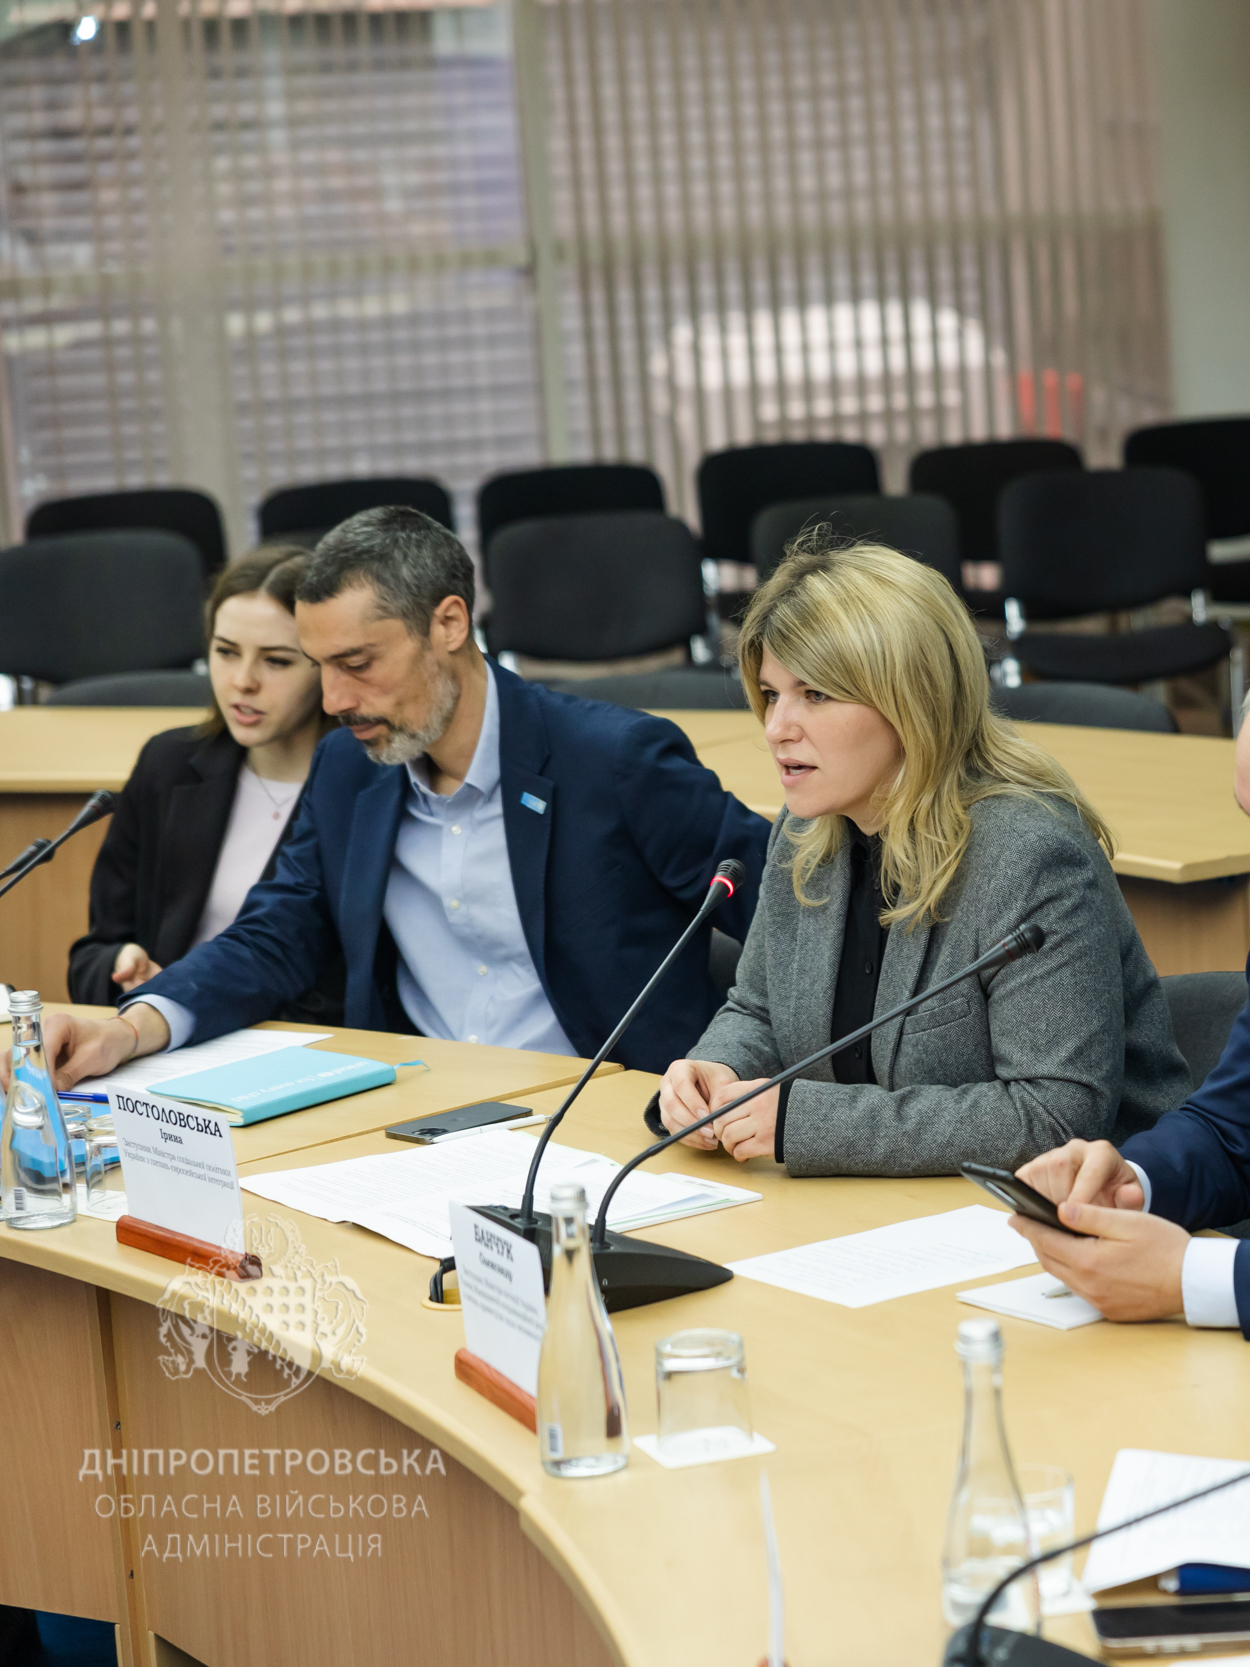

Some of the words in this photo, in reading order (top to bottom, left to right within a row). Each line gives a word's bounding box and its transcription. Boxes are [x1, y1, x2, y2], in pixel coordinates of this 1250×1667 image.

[116, 1094, 223, 1138] ПОСТОЛОВСЬКА
[159, 1128, 183, 1145] Ірина
[473, 1223, 514, 1262] БАНЧУК
